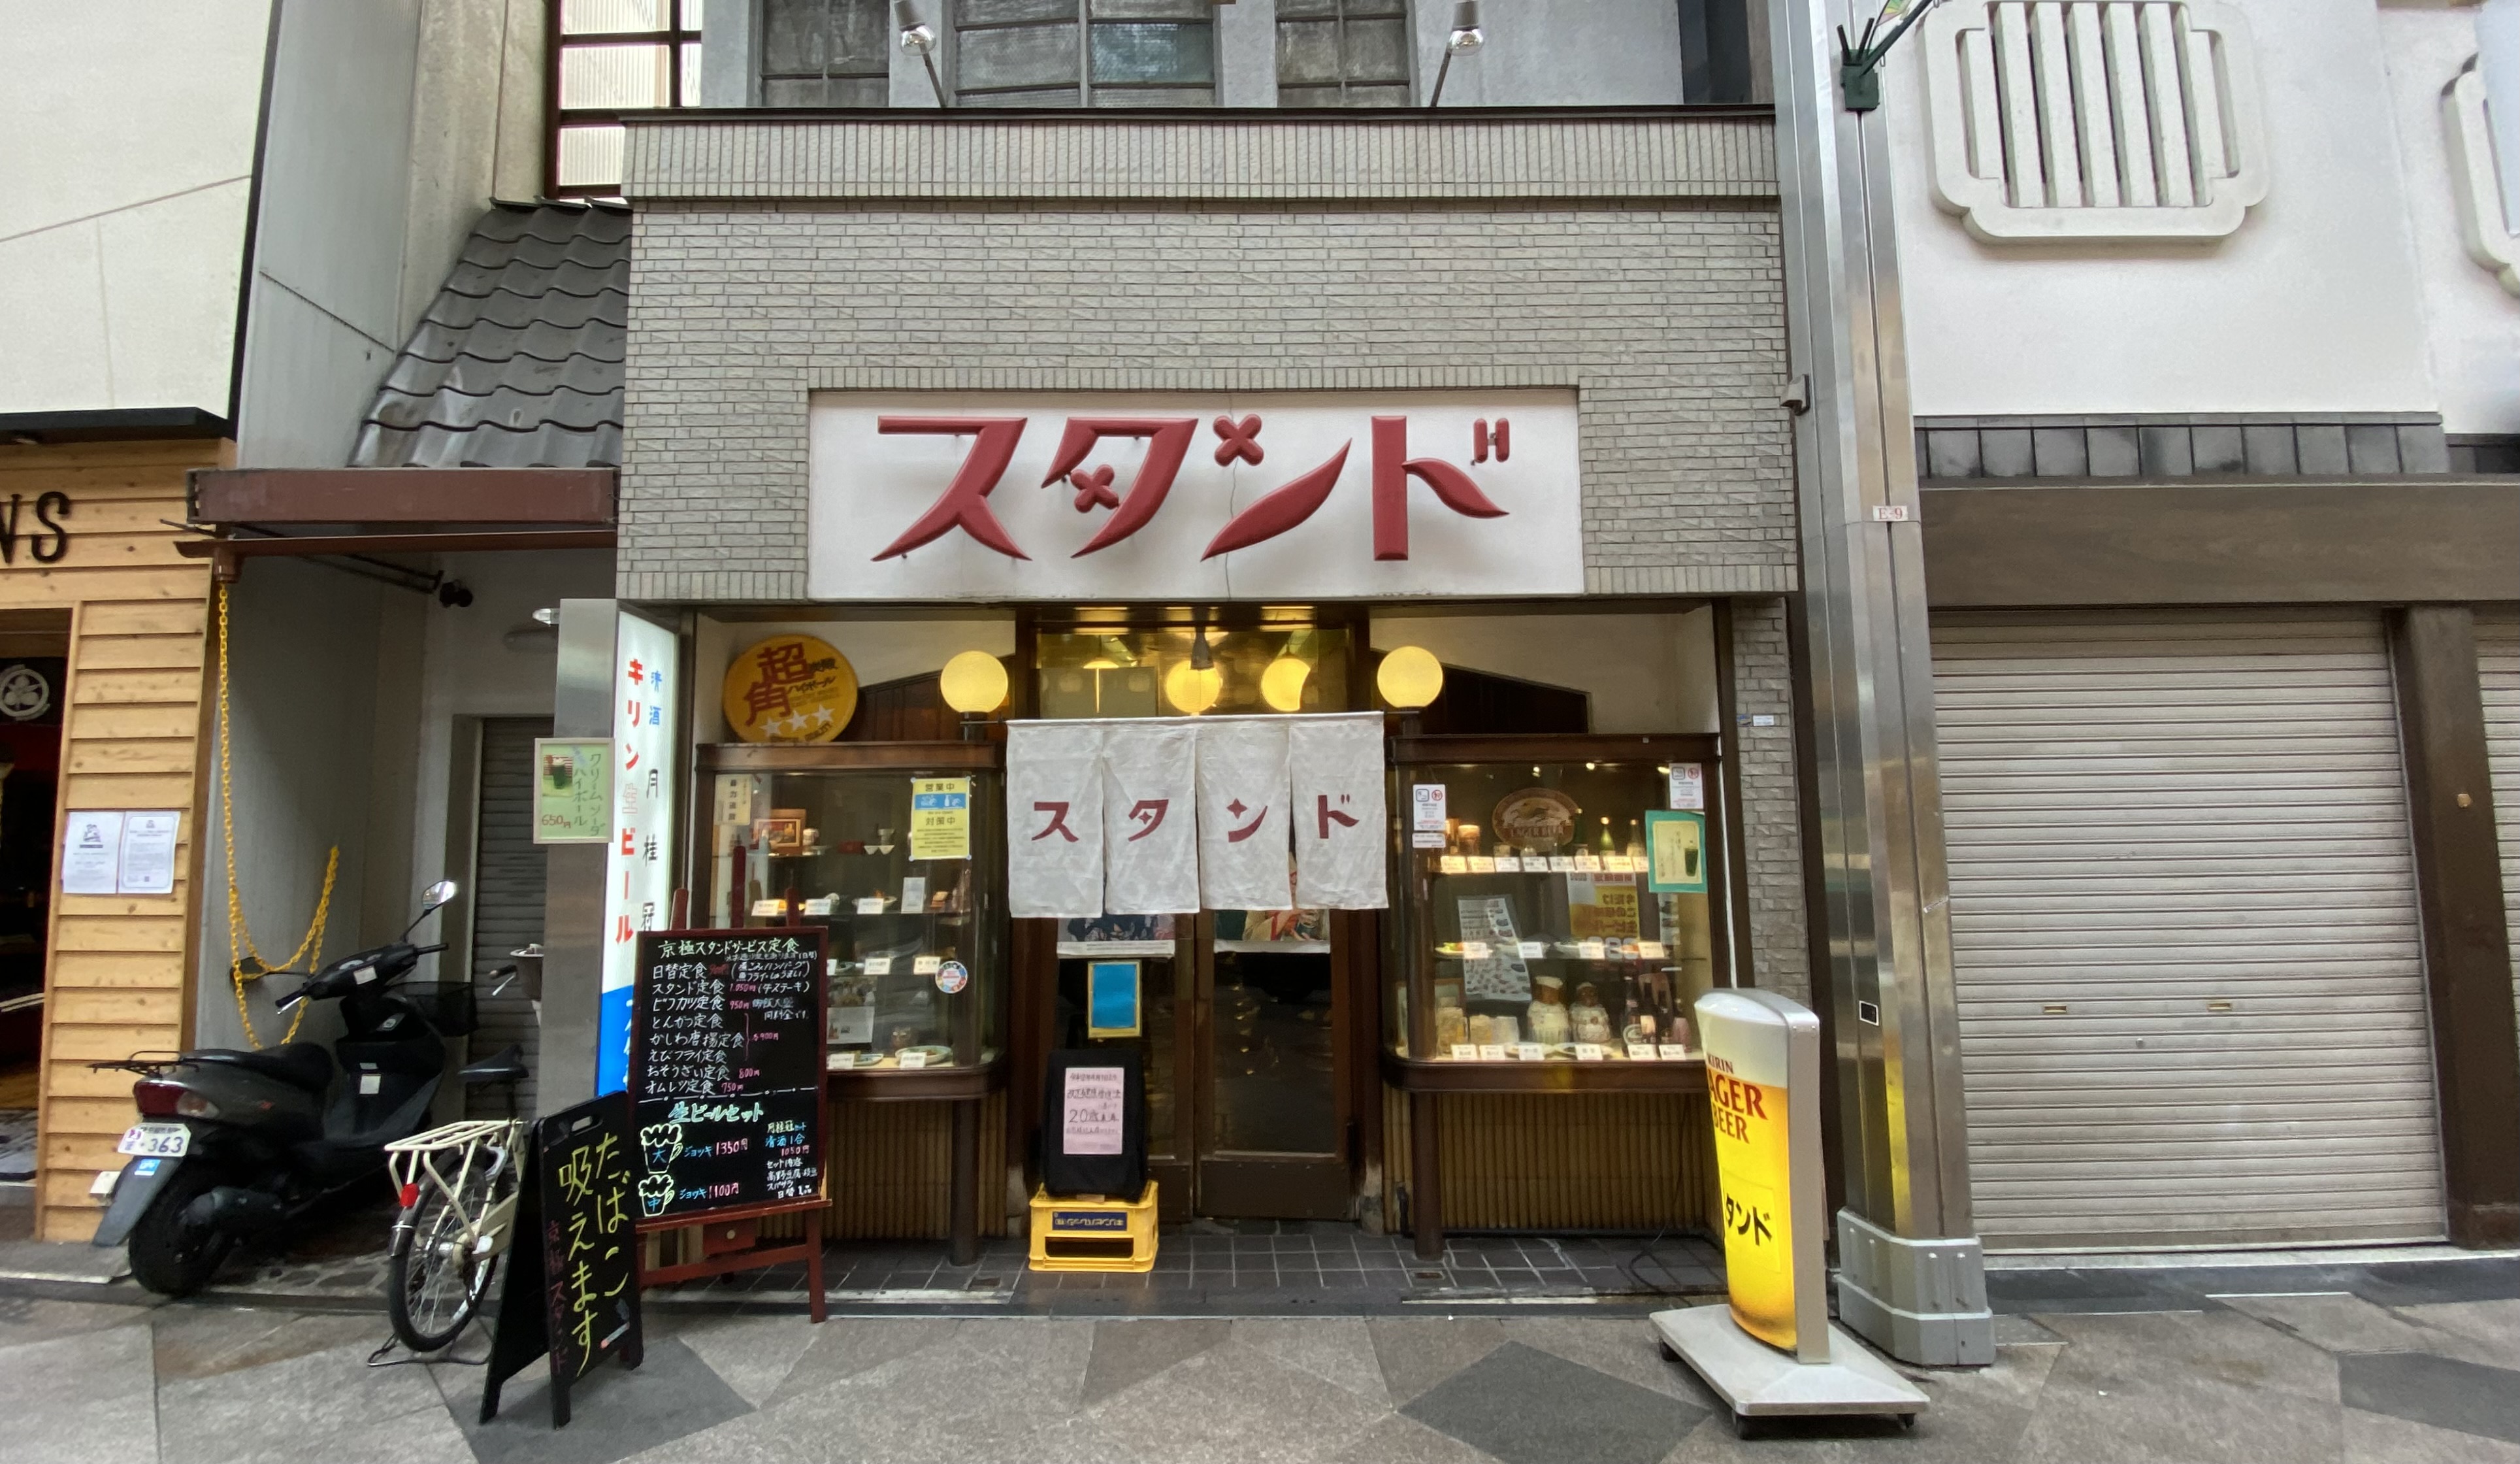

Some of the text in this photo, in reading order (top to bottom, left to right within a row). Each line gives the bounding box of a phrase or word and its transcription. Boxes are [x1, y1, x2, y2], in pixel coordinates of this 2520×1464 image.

[870, 415, 1510, 562] スタンド
[925, 783, 955, 792] 営業中
[541, 814, 571, 829] 650円
[1031, 793, 1360, 843] スタンド
[659, 938, 800, 959] 京極スタンドサービス定食
[653, 962, 708, 980] 日替定食
[652, 979, 725, 995] スタンド定食
[649, 1029, 745, 1048] かしわ唐揚定食
[647, 1049, 727, 1065] えびフライ定食
[647, 1064, 730, 1082] おそうざい定食
[645, 1078, 744, 1095] オムレツ定食 750円
[668, 1102, 764, 1124] 生ビールセット
[652, 1149, 667, 1164] 大
[716, 1138, 749, 1156] 1350円
[781, 1144, 810, 1157] 1050円
[647, 1197, 661, 1212] 中
[559, 1145, 598, 1378] 吸えます
